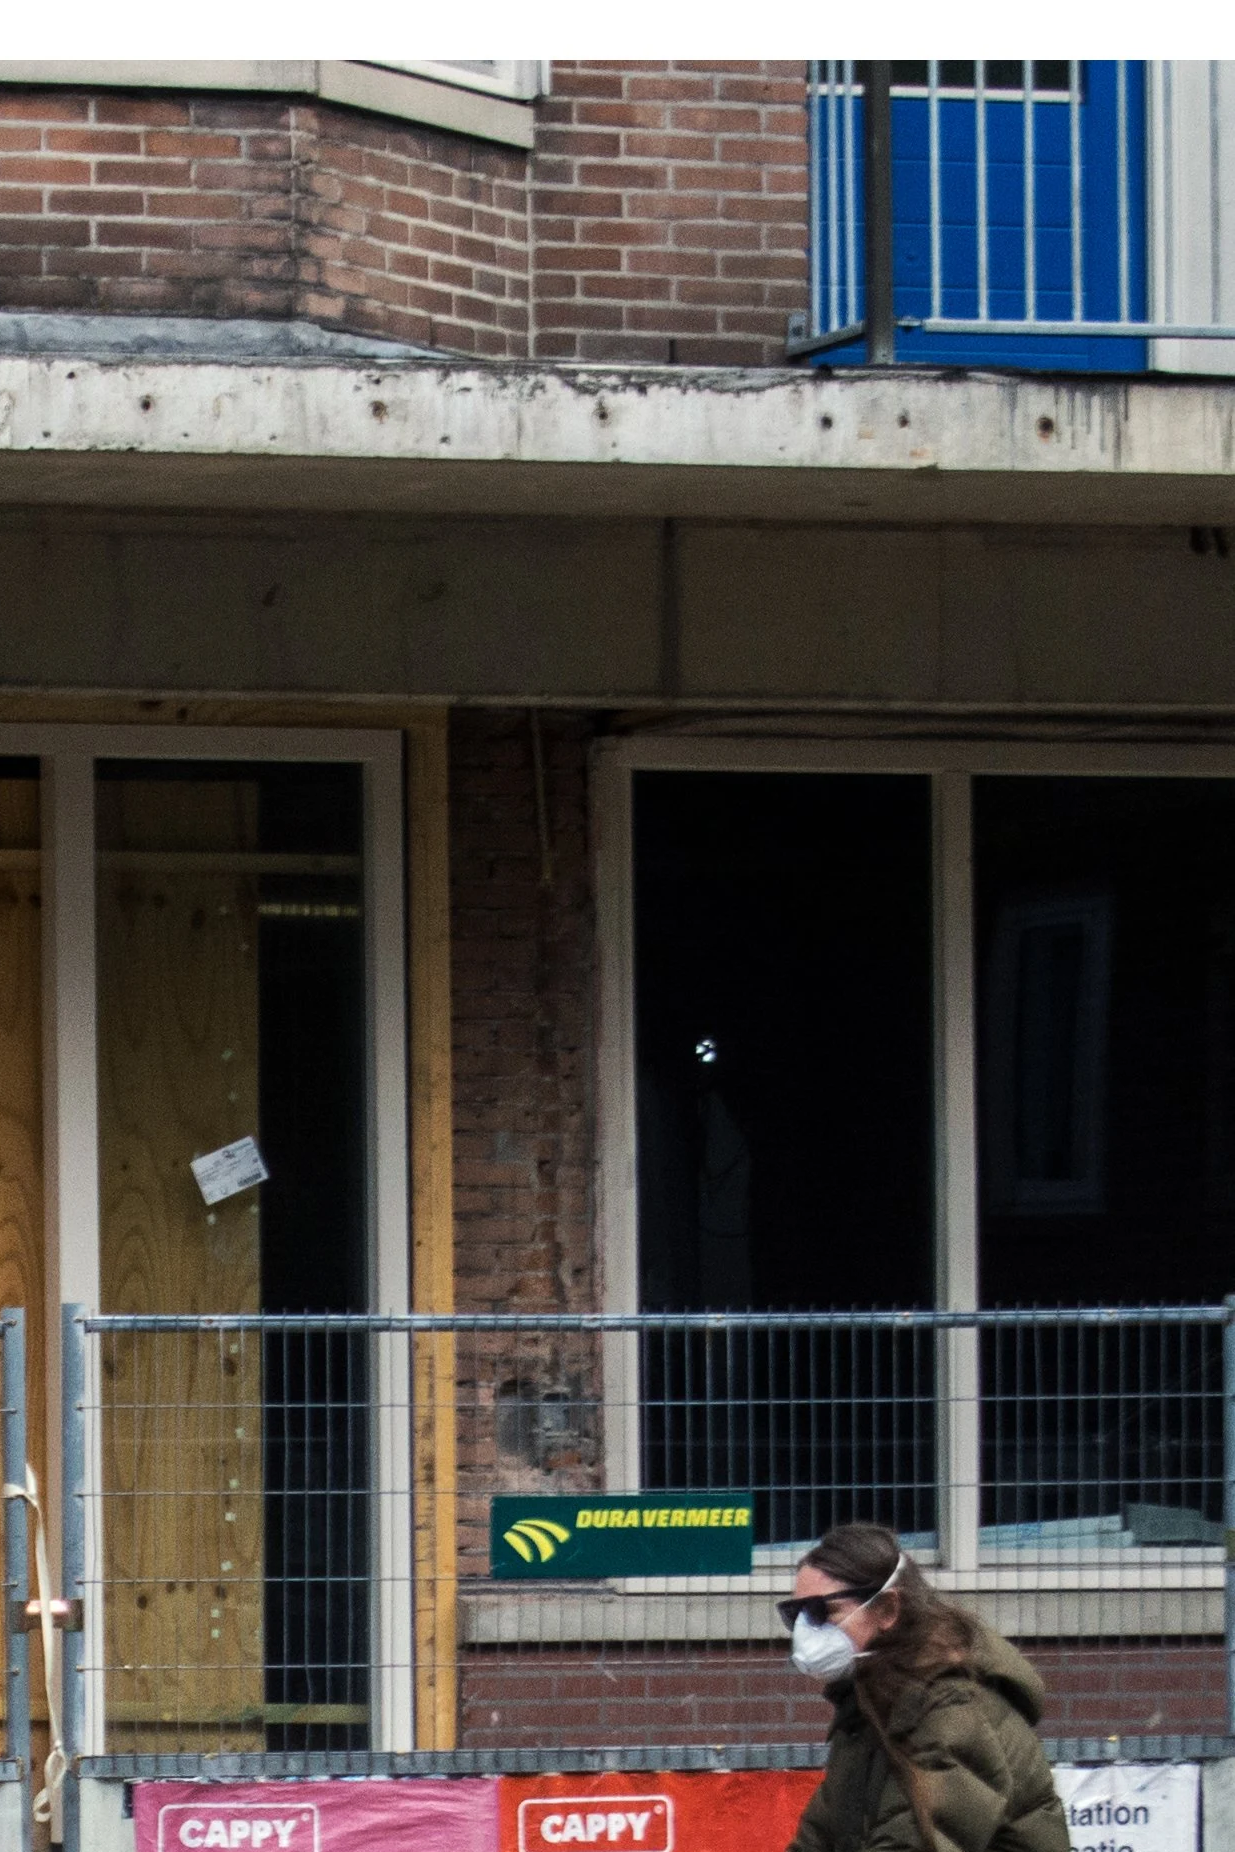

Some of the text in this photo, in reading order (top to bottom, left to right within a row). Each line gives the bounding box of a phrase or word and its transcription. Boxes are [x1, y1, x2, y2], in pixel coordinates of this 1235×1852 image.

[576, 1507, 750, 1528] DURA VERMEER
[179, 1818, 297, 1850] CAPPY
[540, 1812, 651, 1845] CAPPY
